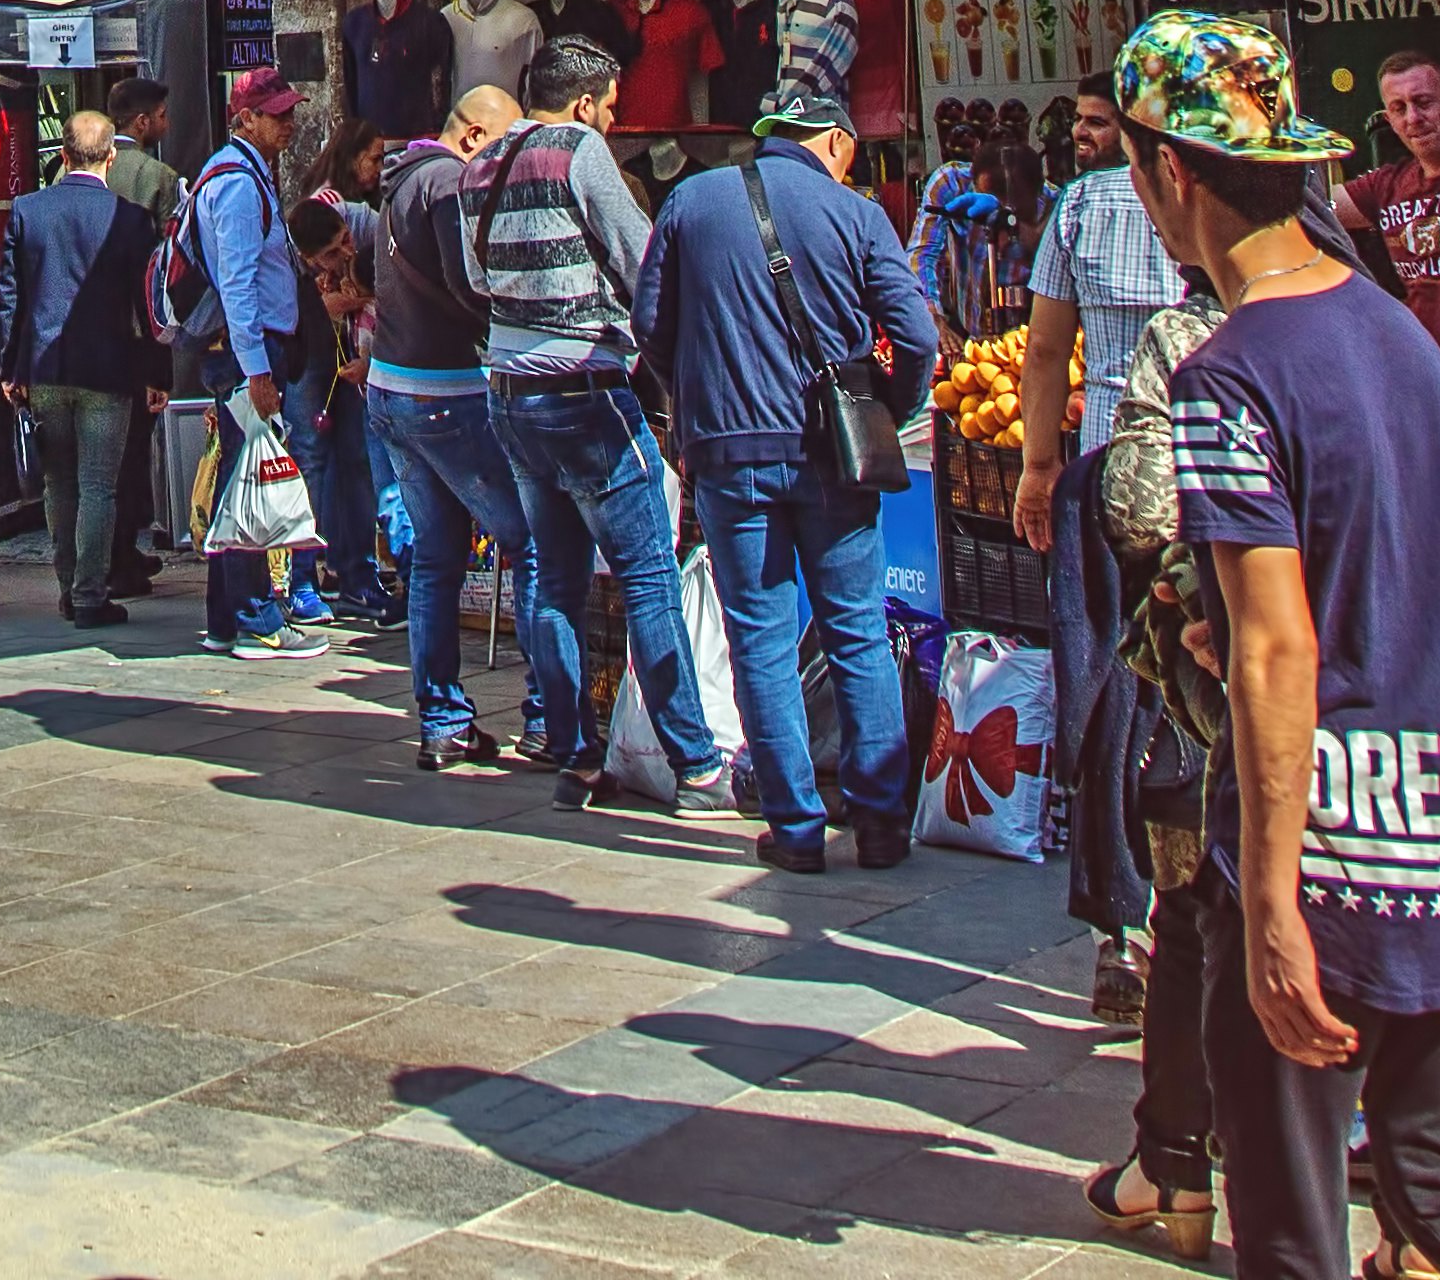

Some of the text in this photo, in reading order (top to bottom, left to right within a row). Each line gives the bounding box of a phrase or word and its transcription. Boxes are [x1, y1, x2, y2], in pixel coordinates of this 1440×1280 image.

[52, 23, 75, 32] GİRİŞ
[49, 35, 77, 43] ENTRY
[232, 42, 259, 64] ALTIN
[1379, 198, 1431, 231] GREAT
